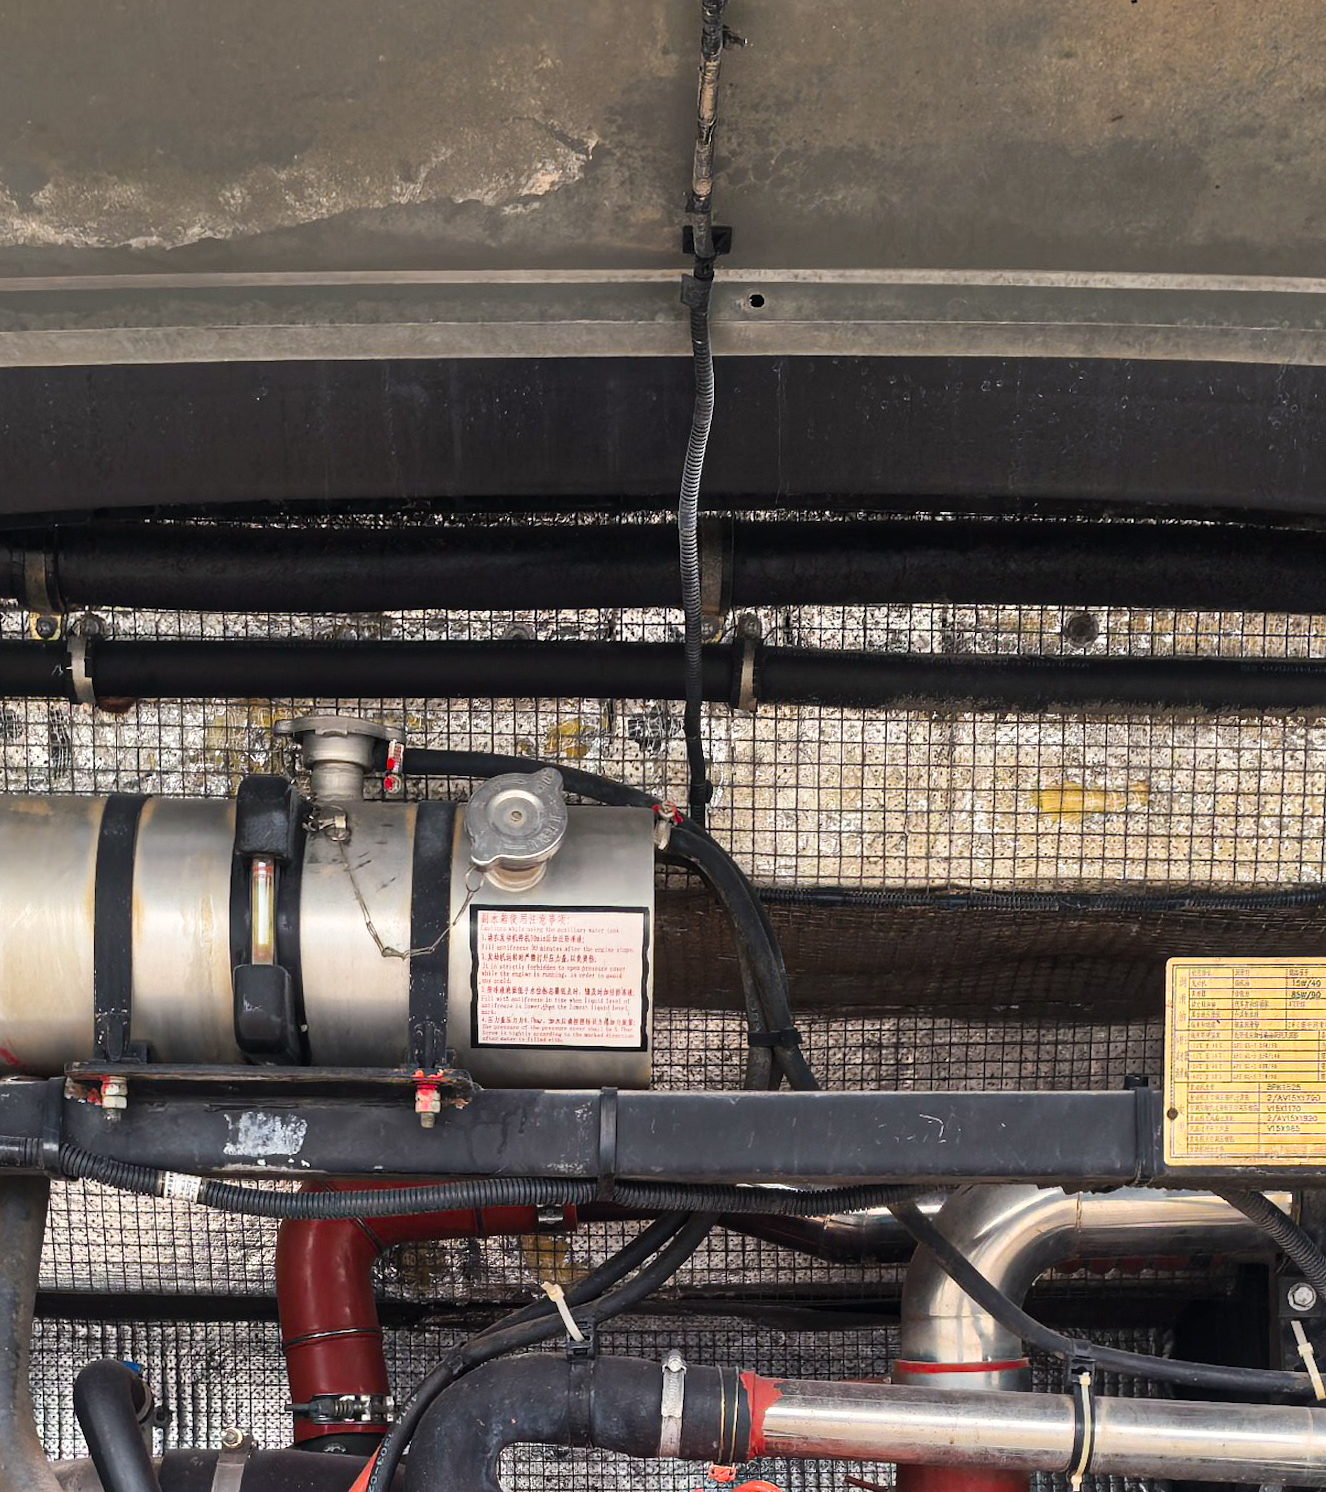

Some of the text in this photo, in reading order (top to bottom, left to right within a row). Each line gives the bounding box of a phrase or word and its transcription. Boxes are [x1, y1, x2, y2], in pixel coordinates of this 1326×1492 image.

[565, 944, 581, 953] after
[583, 944, 593, 953] the
[527, 964, 557, 972] forbidden
[500, 970, 510, 978] the
[1291, 979, 1322, 988] 15W/40
[1290, 990, 1322, 1000] 85W/90
